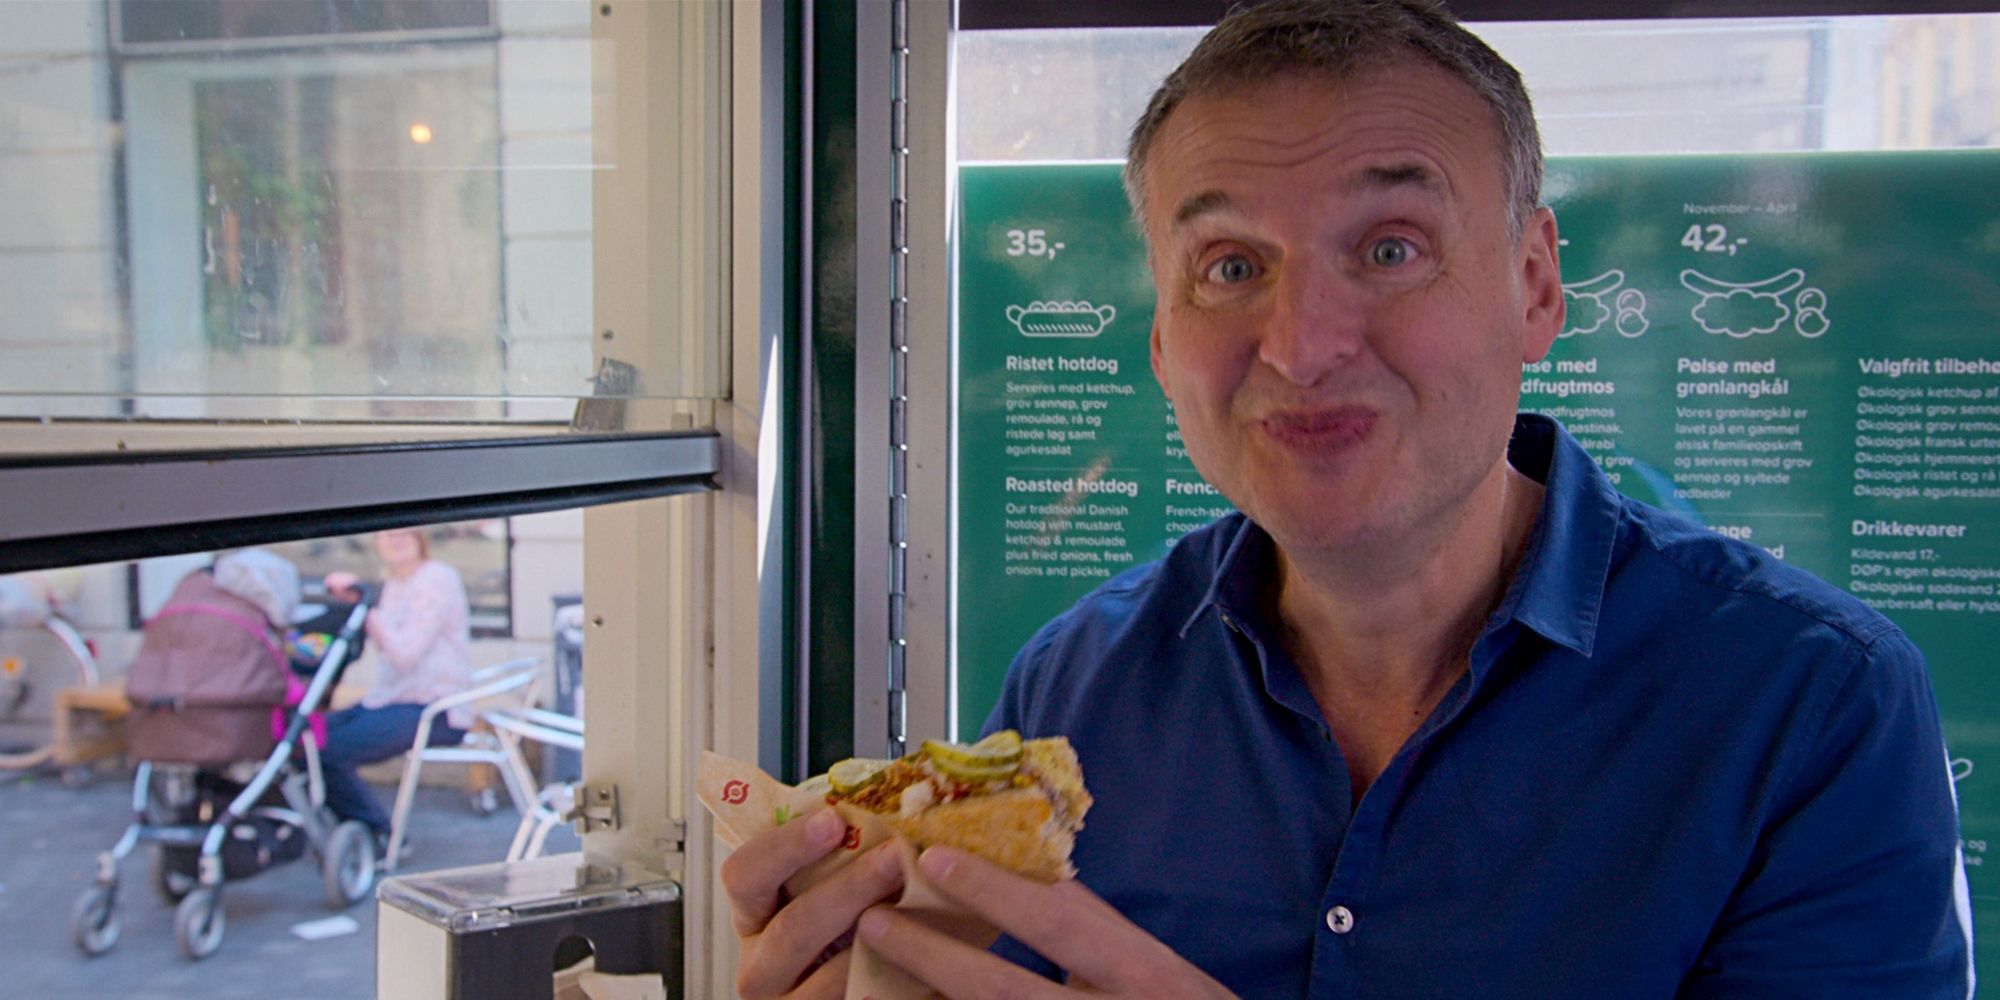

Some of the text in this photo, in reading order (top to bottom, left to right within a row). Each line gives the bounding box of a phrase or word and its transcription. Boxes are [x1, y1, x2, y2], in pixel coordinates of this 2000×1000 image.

[1007, 229, 1065, 259] 35,-
[1681, 224, 1747, 255] 42,-
[1006, 356, 1118, 374] Ristet hotdog
[1522, 358, 1598, 373] lse med
[1677, 358, 1775, 374] Pølse med
[1859, 358, 1929, 377] Valgfrit
[1006, 382, 1135, 397] Serveres med ketchup,
[1677, 379, 1788, 397] grønlangkål
[1006, 399, 1107, 411] grov sennep, grov
[1006, 413, 1101, 428] remoulade, rå og
[1677, 406, 1807, 421] Vores grønlangkål er
[1006, 429, 1095, 443] ristede løg samt
[1676, 422, 1799, 438] lavet på en gammel
[1006, 443, 1071, 458] agurkesalat
[1605, 456, 1634, 468] grov
[1675, 456, 1812, 469] og serveres med grov
[1674, 471, 1789, 486] sennep og syltede
[1006, 478, 1138, 496] Roasted hotdog
[1166, 479, 1218, 494] Frenc
[1006, 503, 1128, 516] Our traditional Danish
[1006, 519, 1124, 532] hotdog with mustard,
[1852, 520, 1966, 537] Drikkevarer
[1006, 534, 1126, 548] ketchup & remoulade
[1006, 550, 1132, 563] plus fried onions, fresh
[1006, 565, 1110, 578] onions and pickles
